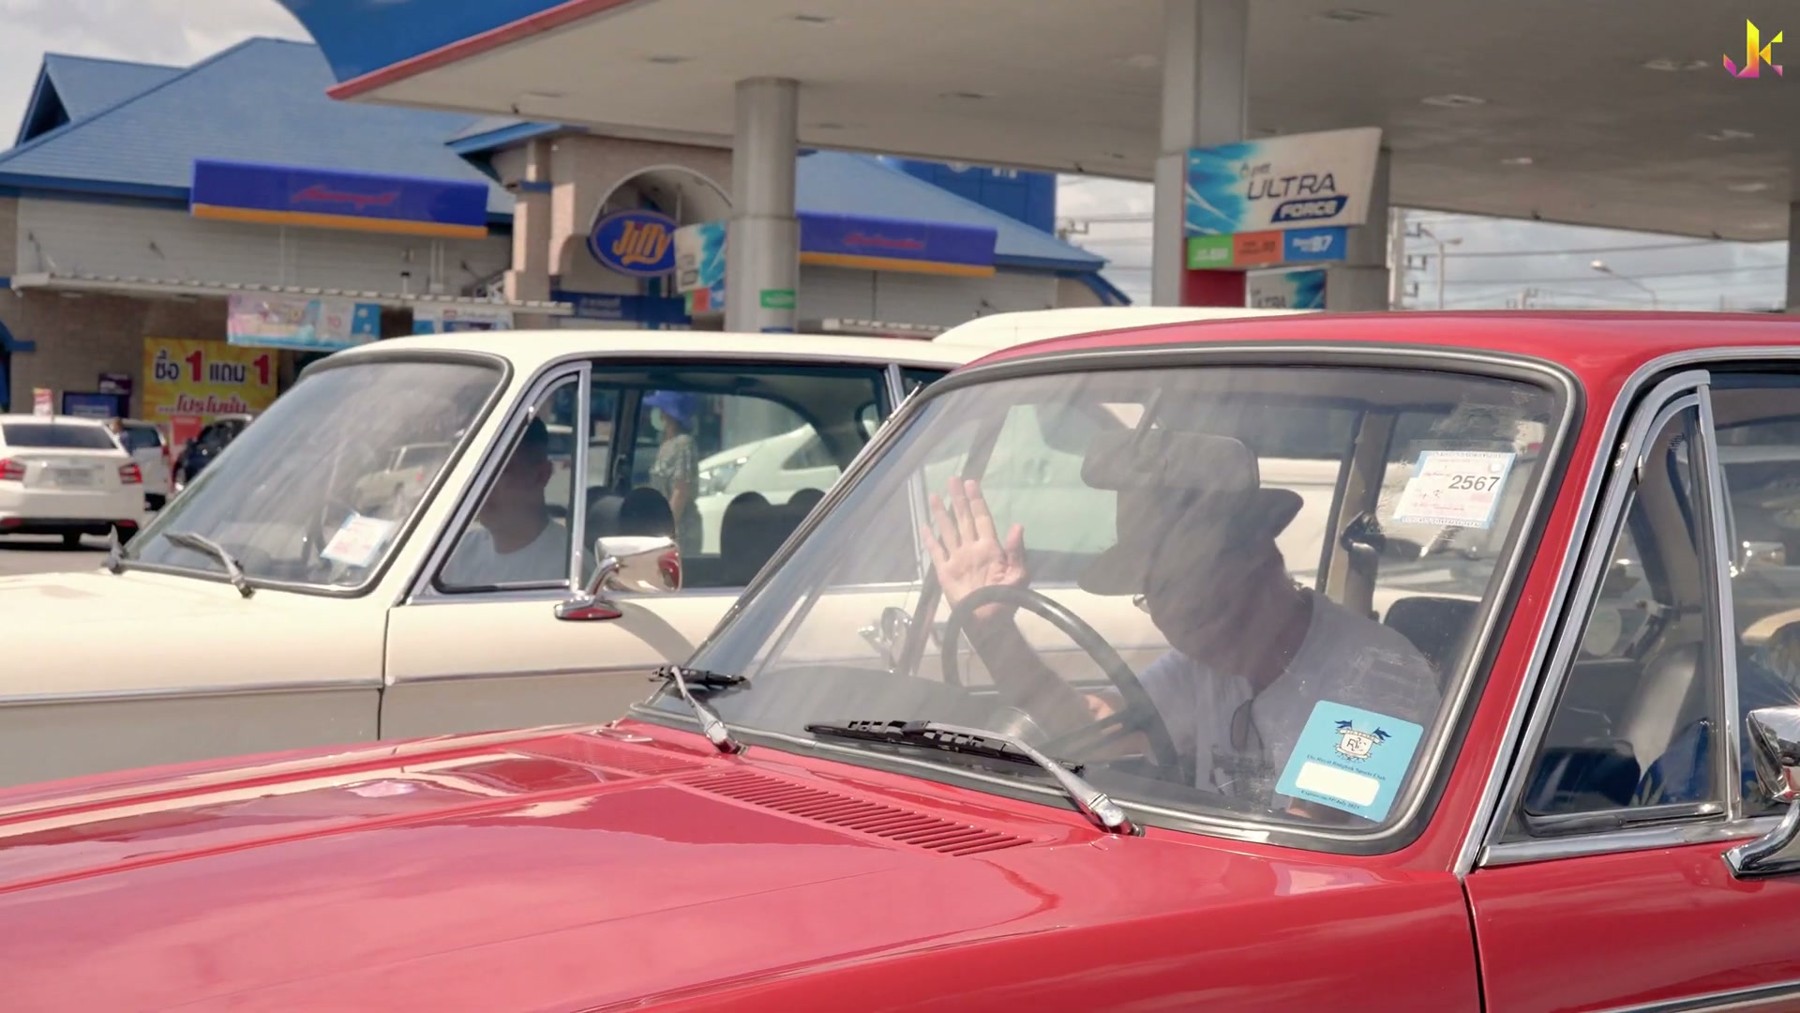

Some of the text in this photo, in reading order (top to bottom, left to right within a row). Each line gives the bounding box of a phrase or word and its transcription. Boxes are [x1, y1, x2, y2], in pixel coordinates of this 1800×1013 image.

[1247, 172, 1336, 201] ULTRA
[1280, 200, 1338, 219] FORCE
[612, 220, 674, 266] Jiffy
[155, 349, 269, 385] ซื้อ 1 แถม 1
[1448, 475, 1501, 492] 2567
